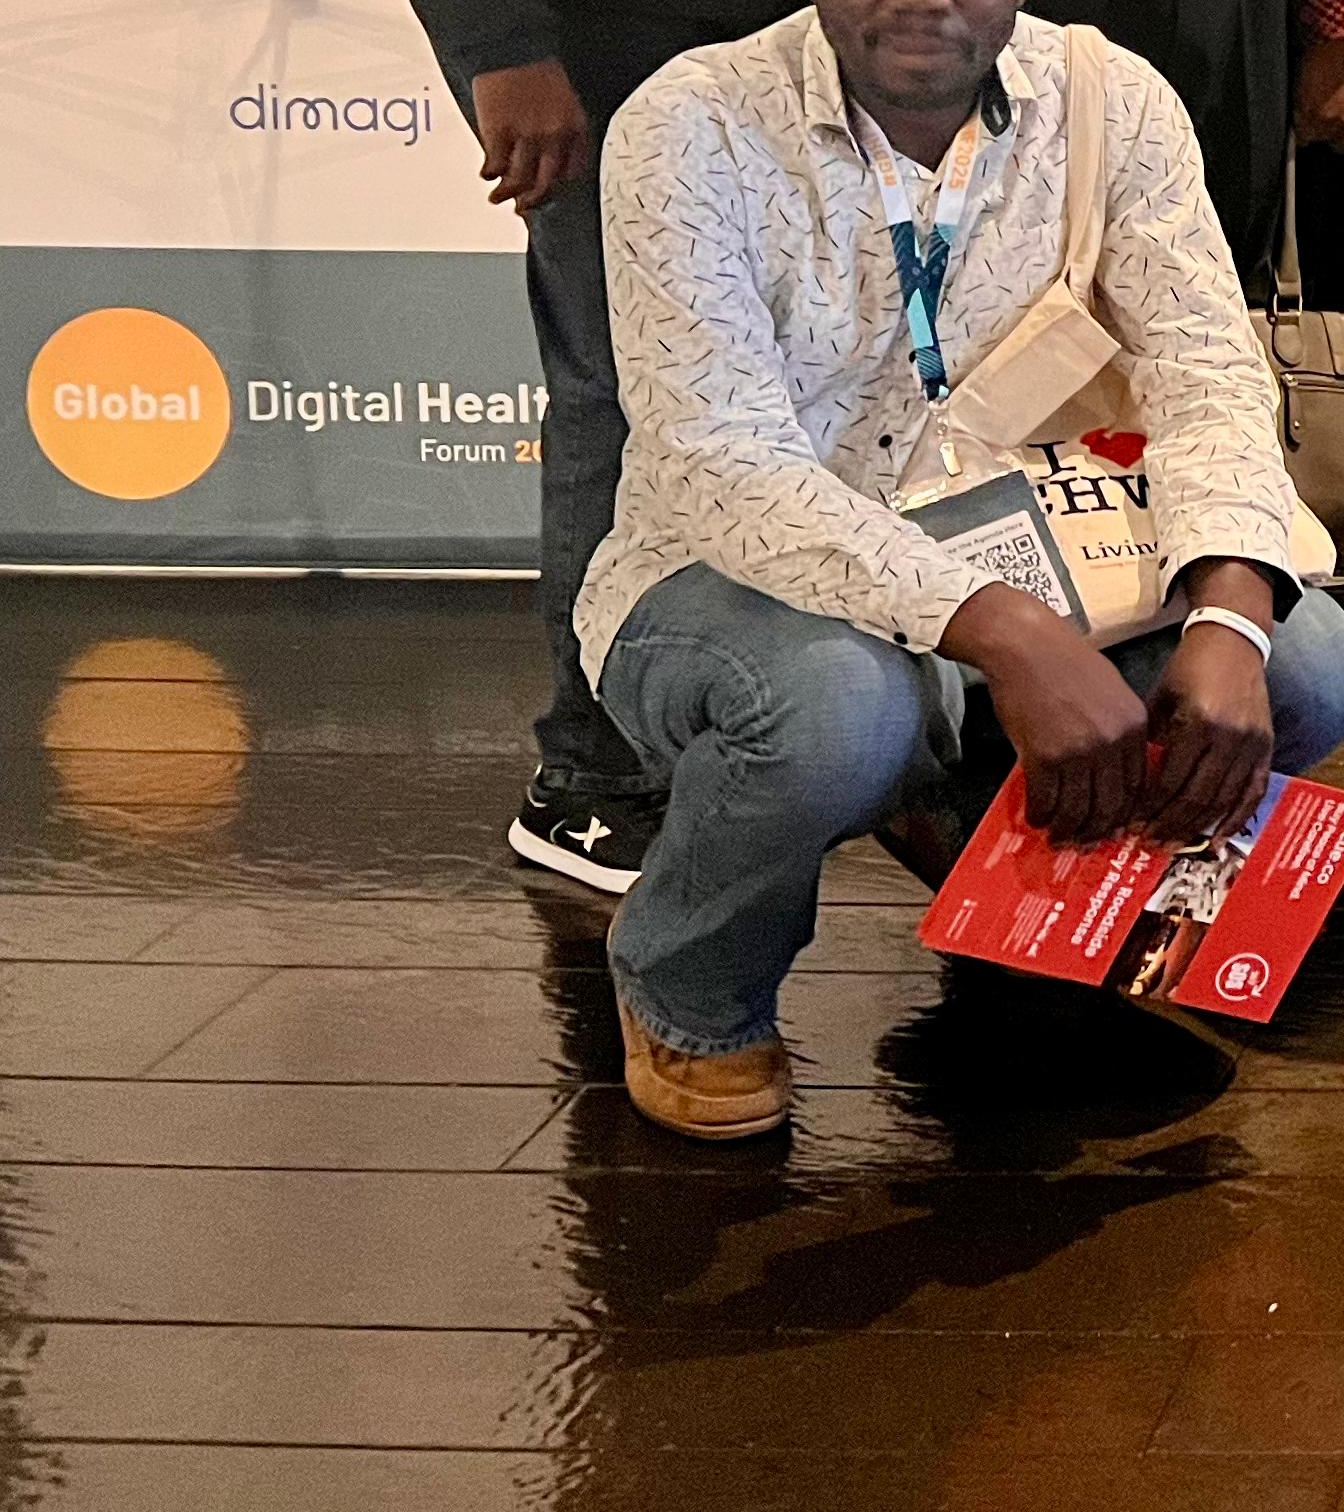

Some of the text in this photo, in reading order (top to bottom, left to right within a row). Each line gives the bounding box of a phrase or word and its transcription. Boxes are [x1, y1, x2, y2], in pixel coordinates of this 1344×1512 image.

[229, 84, 432, 145] dimagi
[54, 382, 201, 422] Global
[248, 381, 404, 432] Digital
[420, 438, 506, 463] Forum
